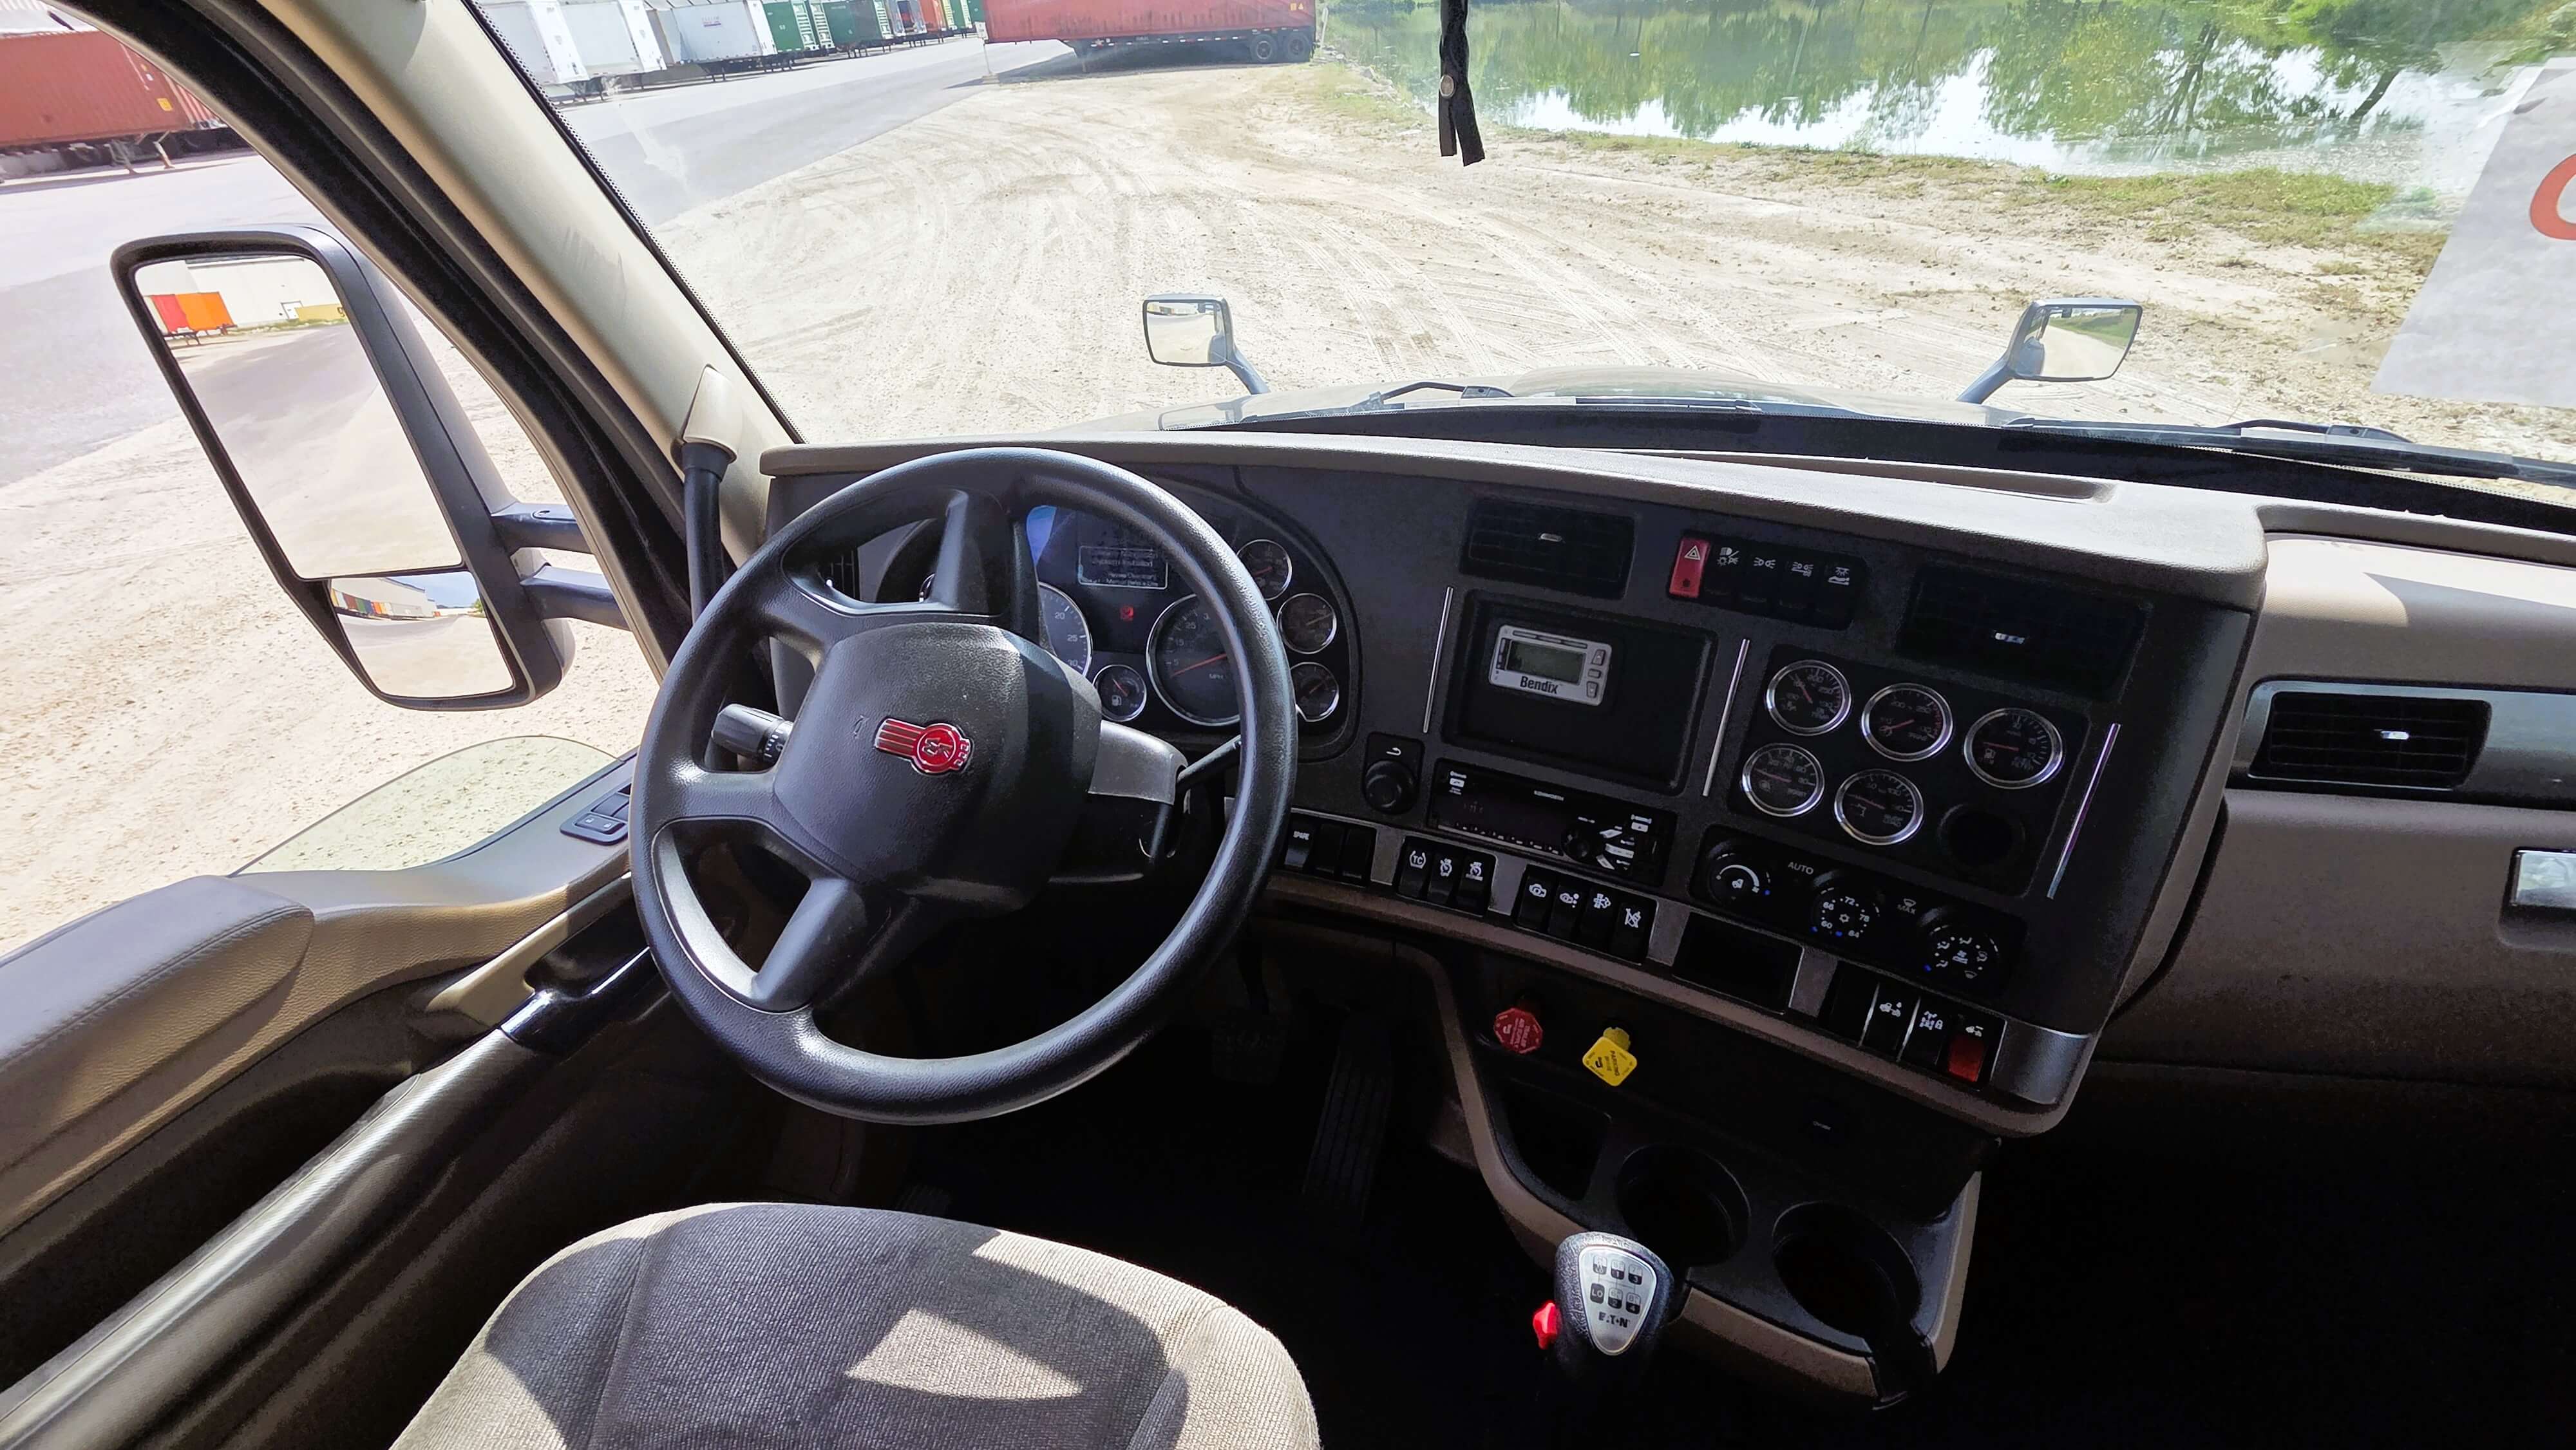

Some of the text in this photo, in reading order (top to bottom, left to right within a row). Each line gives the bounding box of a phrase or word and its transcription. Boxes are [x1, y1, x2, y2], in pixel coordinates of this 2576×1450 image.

[1054, 611, 1066, 620] 20
[1066, 634, 1078, 643] 25
[1519, 675, 1559, 695] Bendix
[1414, 855, 1423, 865] TC
[1788, 861, 1814, 875] AUTO
[1823, 901, 1835, 911] 66
[1844, 896, 1856, 906] 72
[1896, 903, 1917, 915] MAX
[1859, 914, 1870, 923] 78
[1821, 919, 1833, 929] 60
[1848, 929, 1860, 938] 84
[1610, 1050, 1620, 1077] PARKING
[1591, 1288, 1604, 1298] LO
